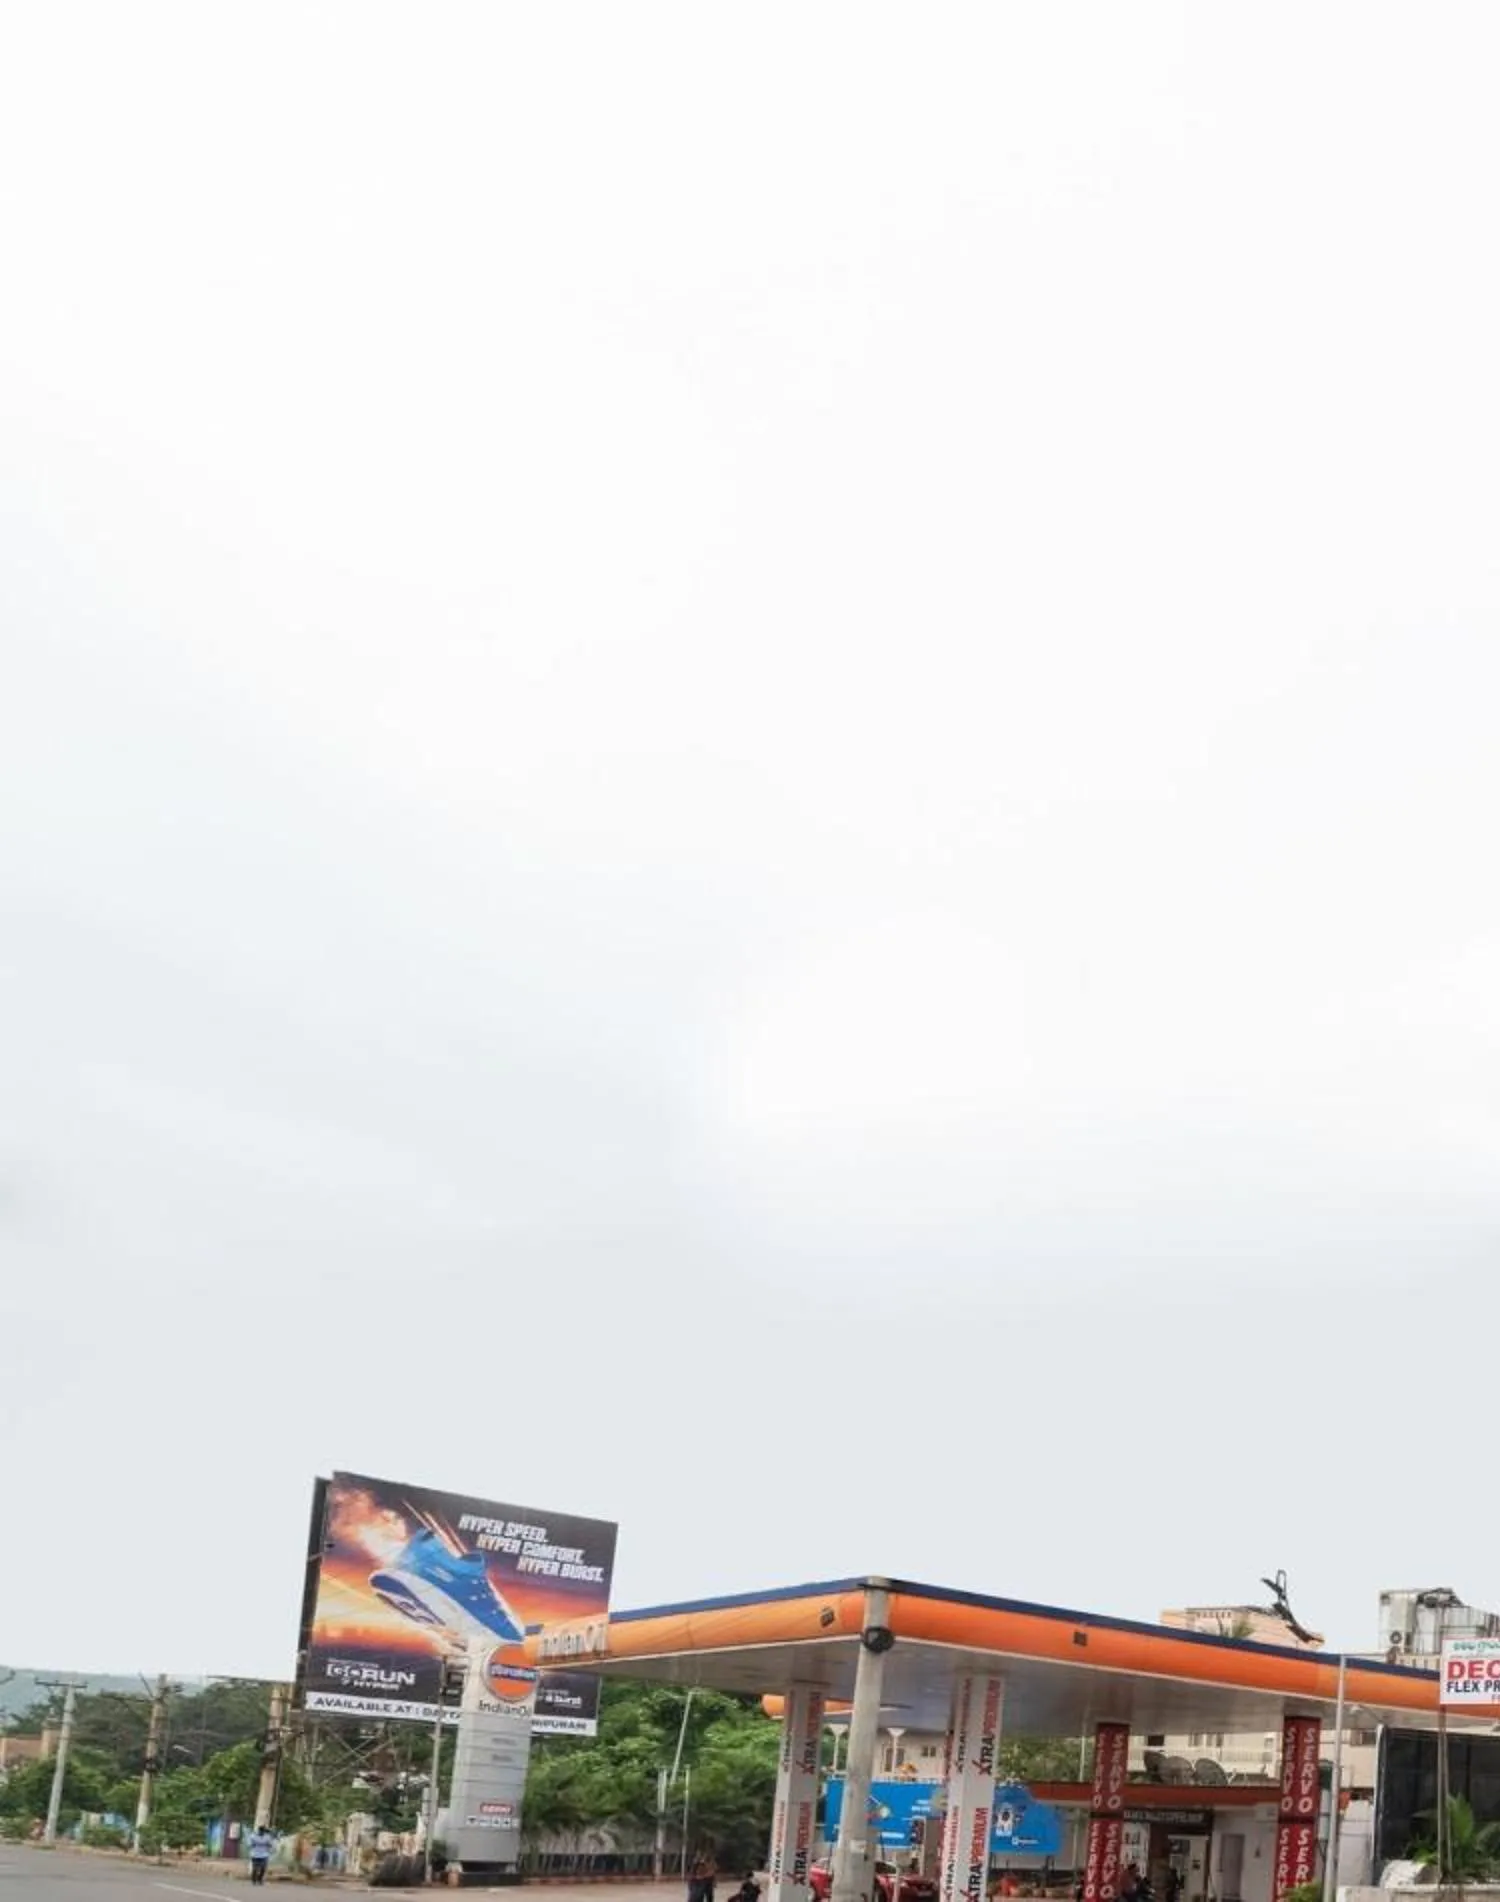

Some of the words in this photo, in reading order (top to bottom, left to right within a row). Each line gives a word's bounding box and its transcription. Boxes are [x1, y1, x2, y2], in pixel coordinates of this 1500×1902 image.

[458, 1513, 505, 1536] HYPER
[476, 1533, 522, 1554] HYPER
[516, 1555, 560, 1576] HYPER
[1446, 1679, 1480, 1693] FLEX
[314, 1696, 393, 1714] AVAILABLE
[1298, 1728, 1315, 1813] SERVO
[1100, 1824, 1120, 1899] SERVO
[1276, 1828, 1290, 1902] SERV
